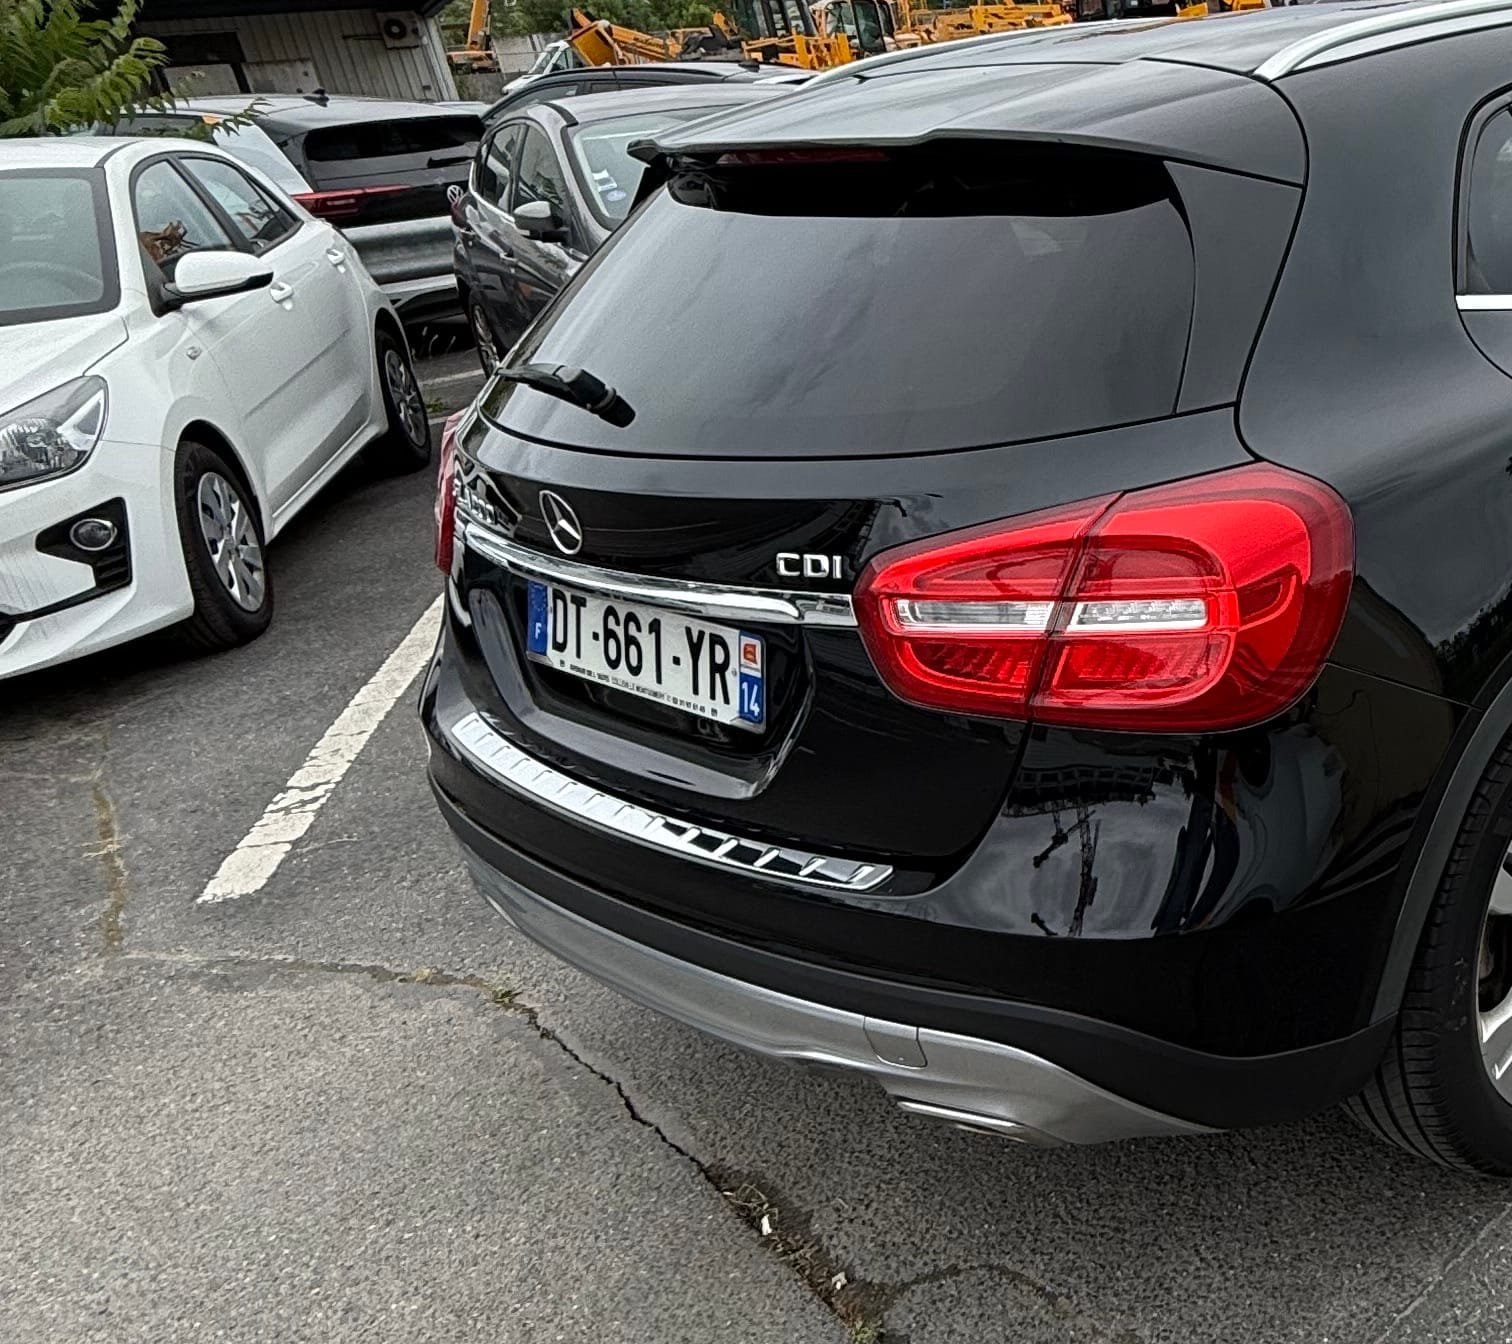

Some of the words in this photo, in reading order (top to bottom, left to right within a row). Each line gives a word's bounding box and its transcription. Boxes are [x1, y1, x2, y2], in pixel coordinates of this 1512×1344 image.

[776, 552, 842, 579] CDI
[534, 622, 543, 640] F
[551, 587, 731, 706] DT-661-YR
[741, 680, 761, 717] 14
